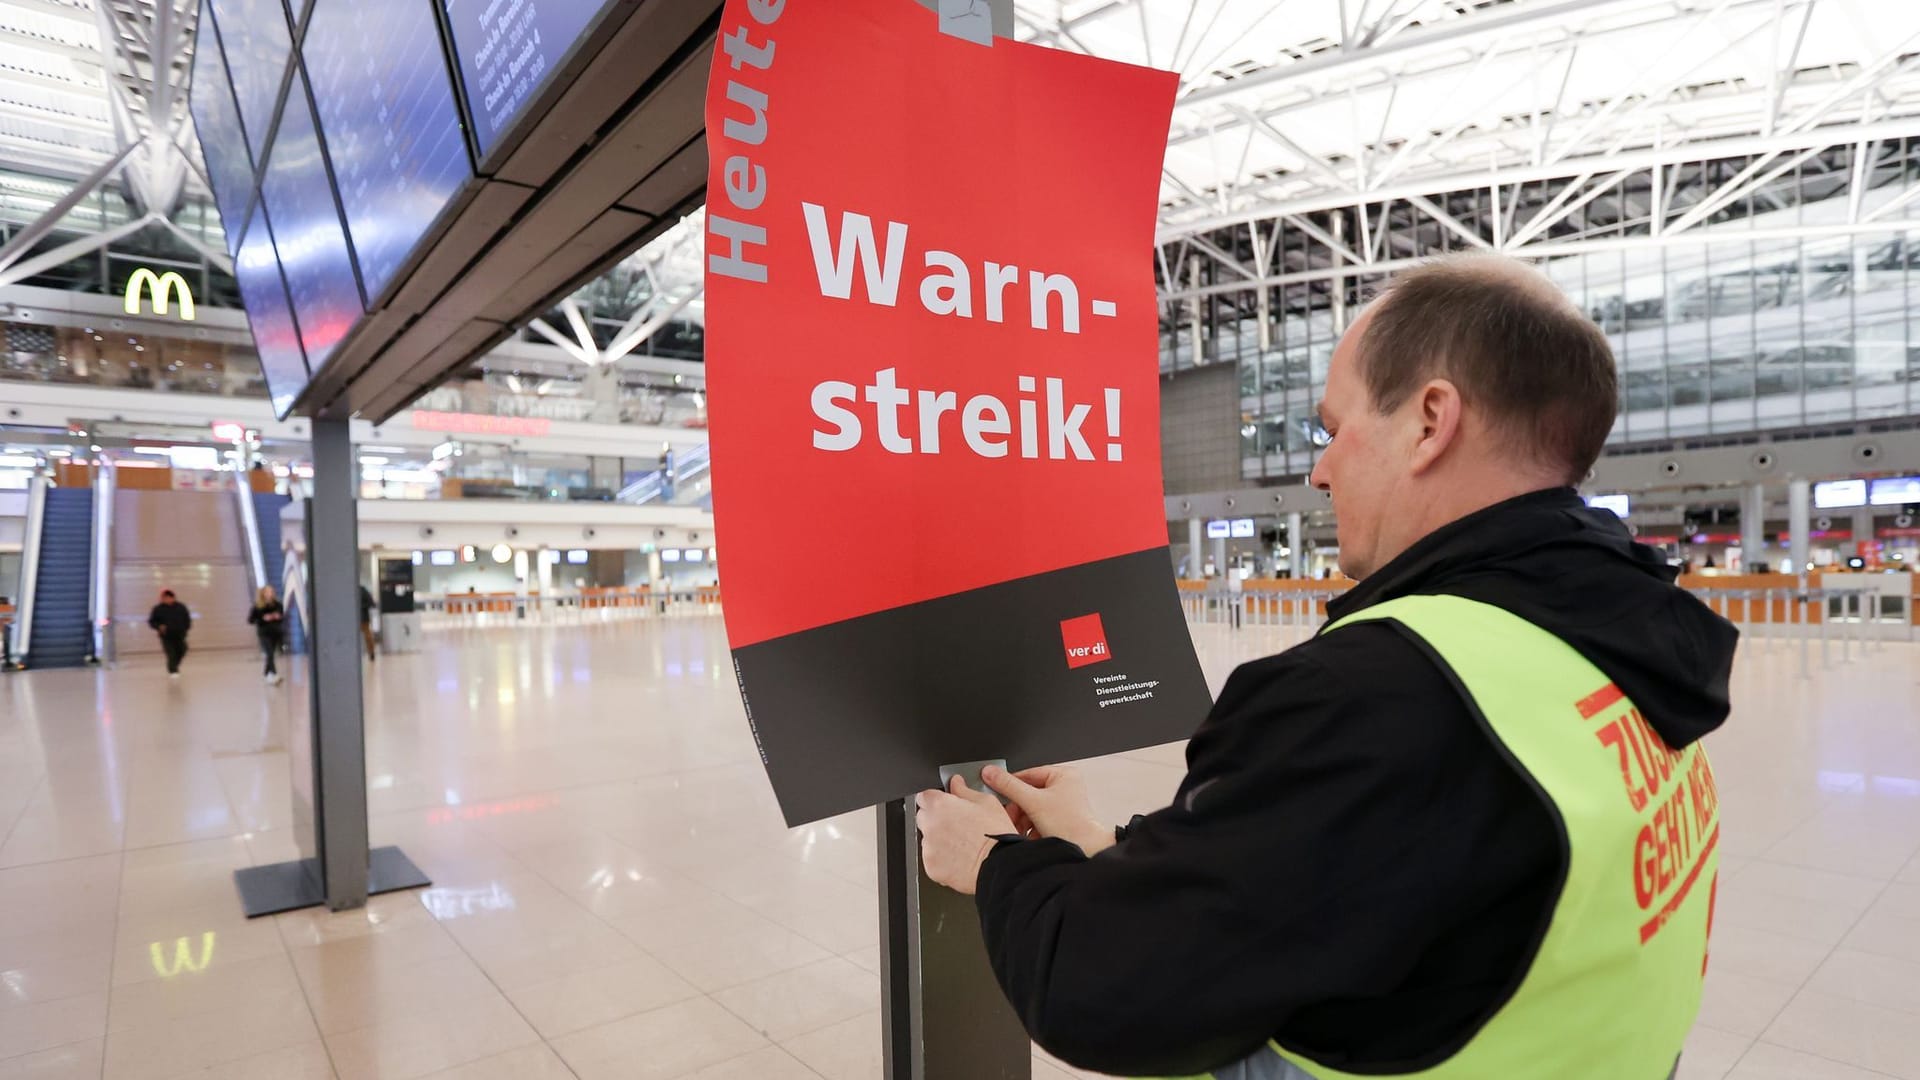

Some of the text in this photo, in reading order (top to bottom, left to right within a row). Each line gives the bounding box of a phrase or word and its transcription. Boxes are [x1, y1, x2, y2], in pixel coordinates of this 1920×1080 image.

[801, 202, 1117, 334] Warn-
[810, 367, 1123, 462] streik!
[1093, 674, 1127, 685] Vereinte
[1096, 680, 1159, 696] Dienstleistungs-
[1099, 691, 1153, 708] gewerkschaft
[1633, 781, 1690, 910] GEHT
